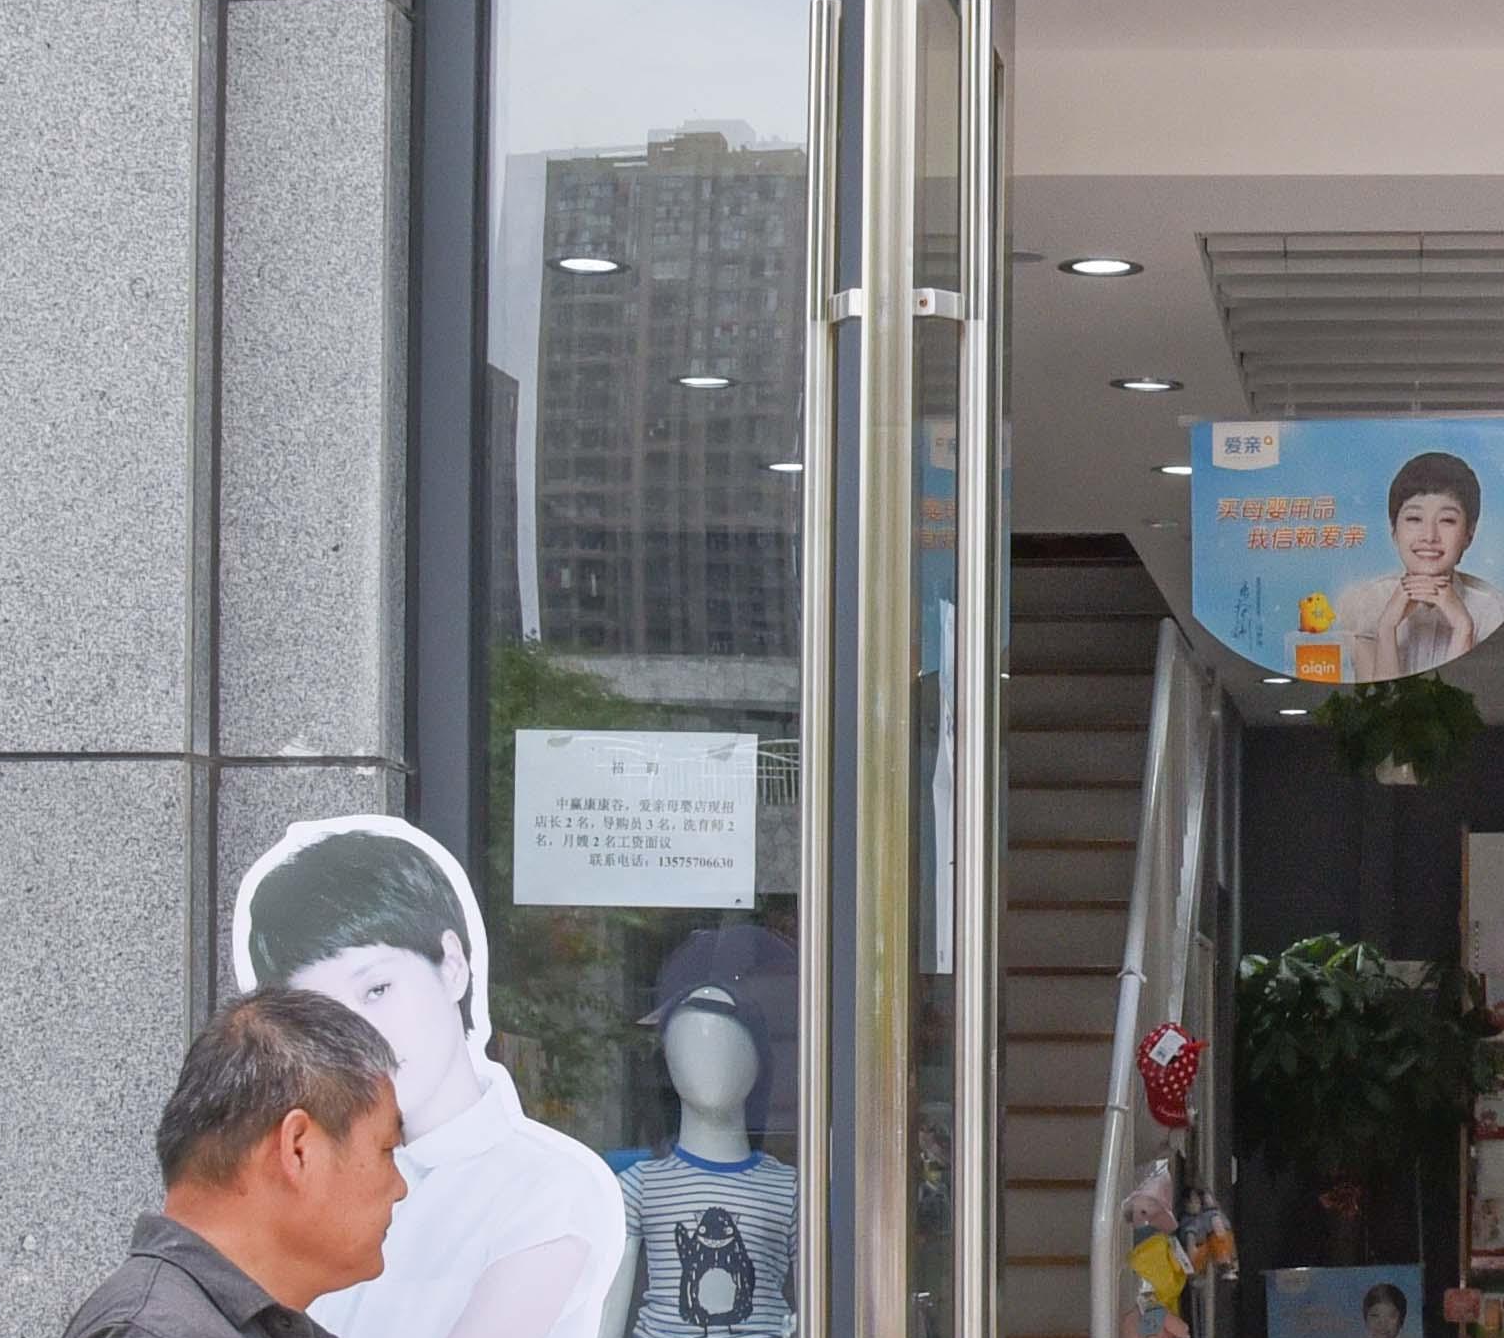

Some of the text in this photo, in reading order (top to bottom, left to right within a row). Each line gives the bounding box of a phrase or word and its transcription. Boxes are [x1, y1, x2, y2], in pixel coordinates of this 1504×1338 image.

[1224, 436, 1262, 454] 爱亲
[1216, 495, 1337, 522] 买母婴用品
[1248, 524, 1367, 550] 我信赖爱亲
[1301, 662, 1336, 675] aiqin
